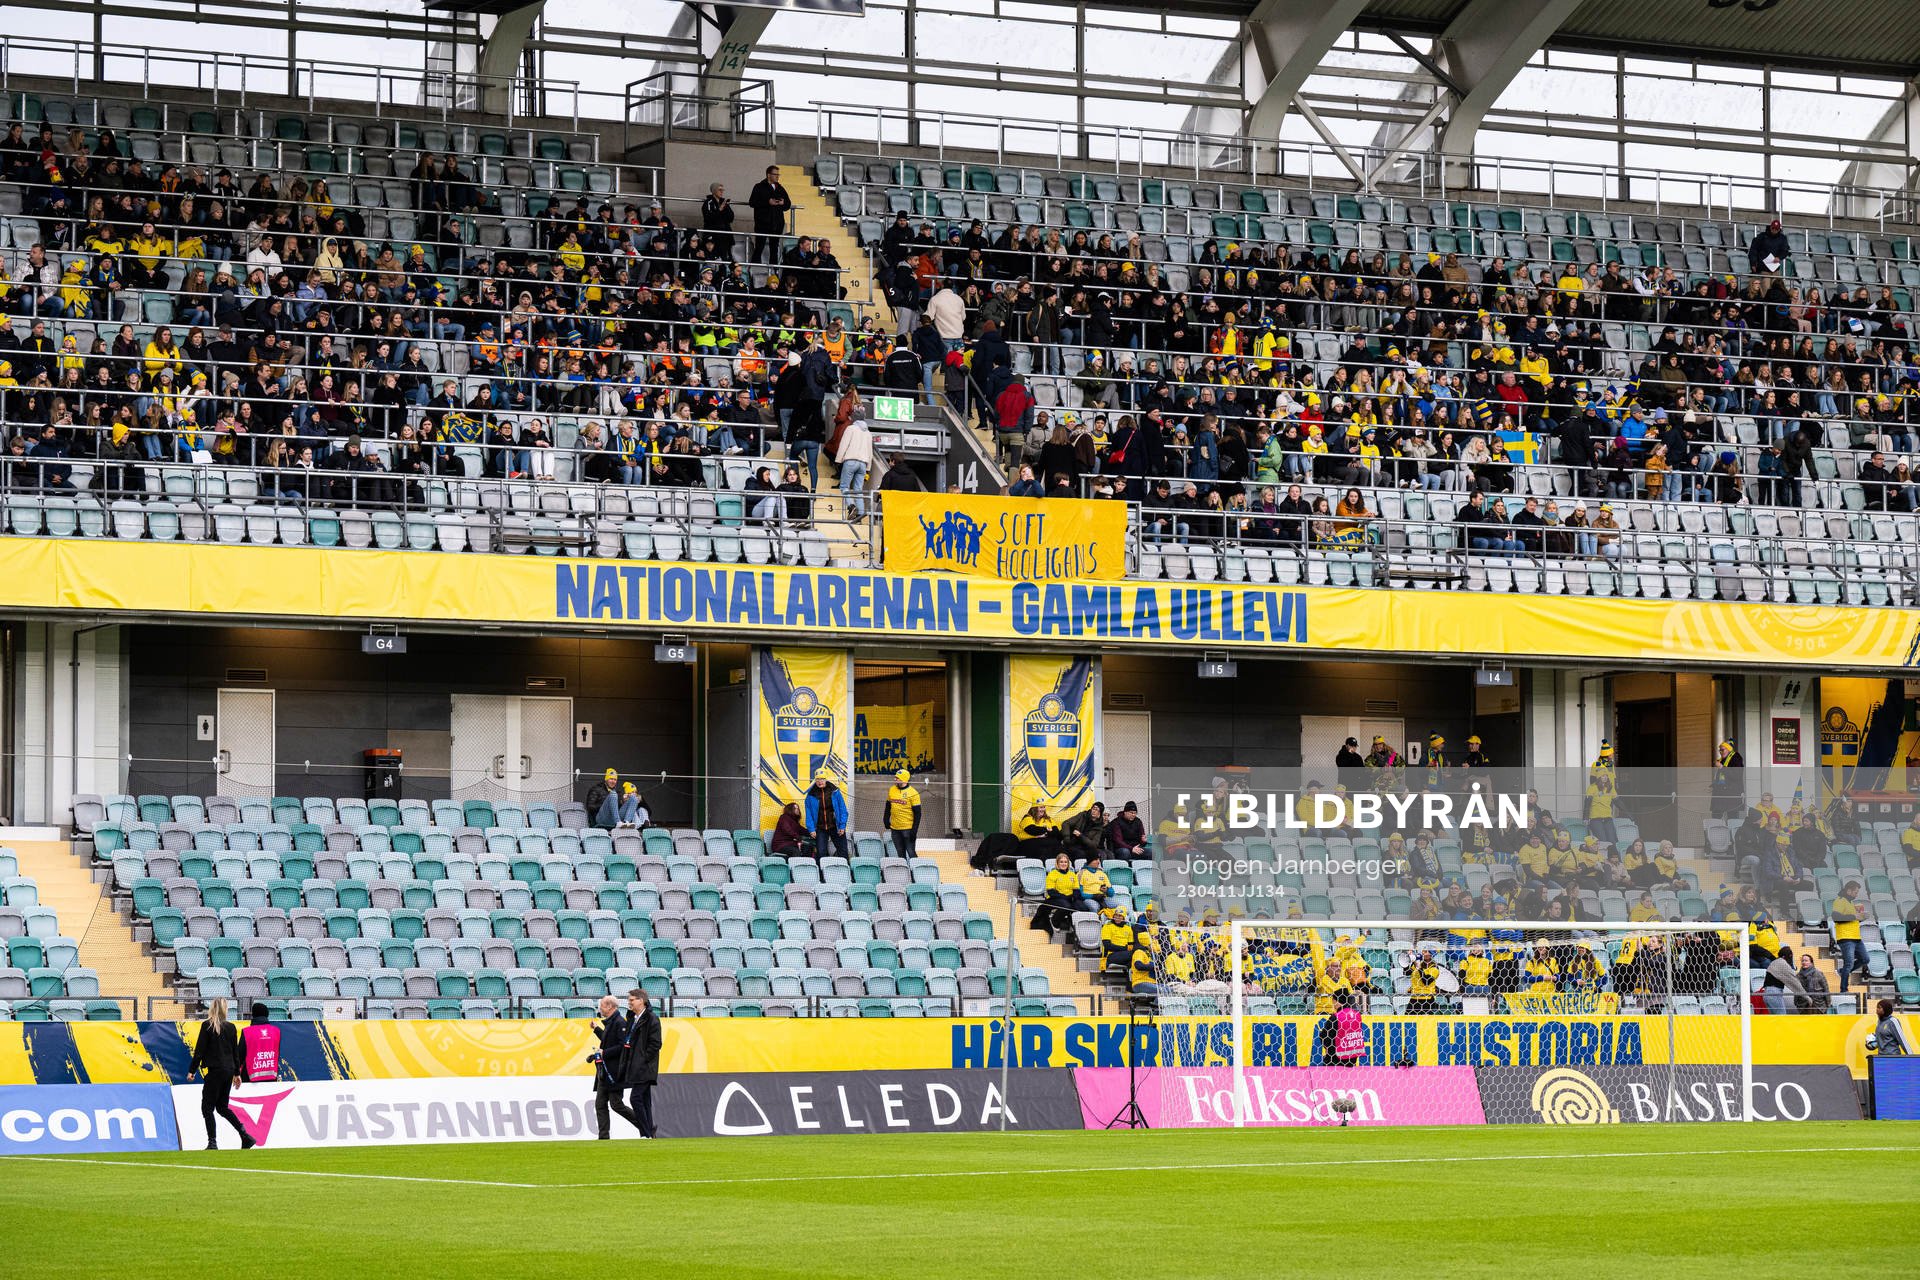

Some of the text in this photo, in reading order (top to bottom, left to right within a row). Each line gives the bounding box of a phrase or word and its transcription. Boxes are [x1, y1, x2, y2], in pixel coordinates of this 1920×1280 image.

[996, 512, 1045, 545] SOFT
[997, 542, 1097, 580] HOOLIGANS
[556, 564, 968, 632] NATIONALARENAN
[1012, 582, 1161, 638] GAMLA
[1171, 589, 1307, 643] ULLEVI
[376, 639, 393, 650] G4
[668, 648, 684, 659] G5
[1786, 635, 1828, 652] 1904
[783, 718, 825, 727] SVERIGE
[1031, 724, 1073, 732] SVERIGE
[951, 1018, 1053, 1069] HÄR
[1065, 1021, 1234, 1068] SKRIVS
[1437, 1020, 1643, 1066] HISTORIA
[476, 1058, 535, 1075] 1904
[789, 1081, 1018, 1129] ELEDA
[1176, 1075, 1388, 1123] Folksam
[1627, 1082, 1812, 1122] BASECO
[1, 1107, 157, 1142] com
